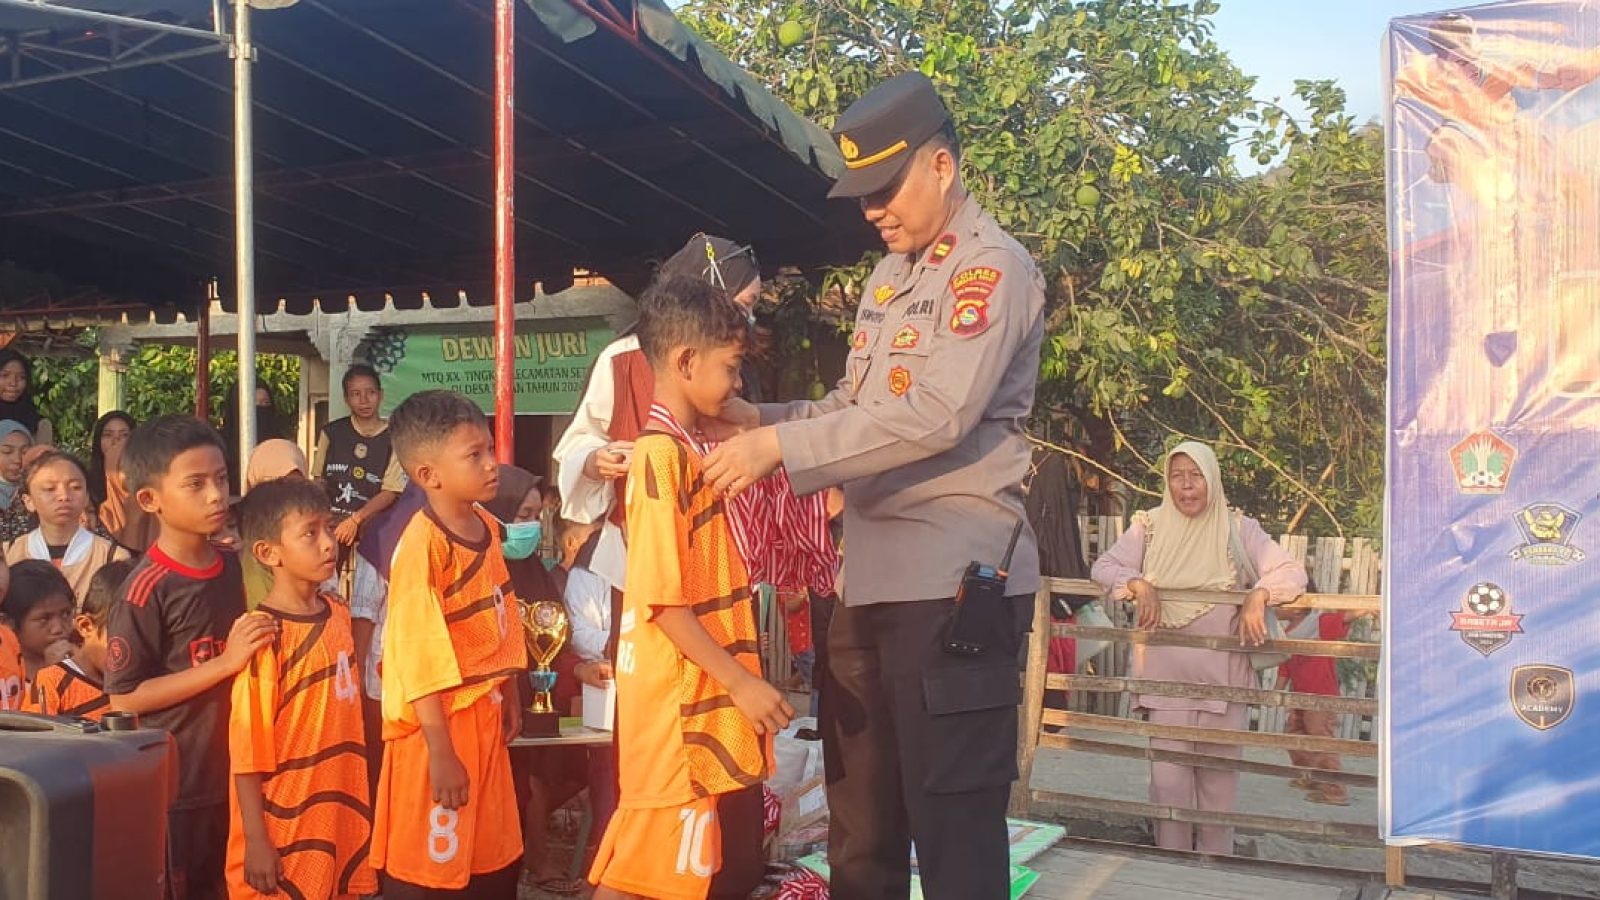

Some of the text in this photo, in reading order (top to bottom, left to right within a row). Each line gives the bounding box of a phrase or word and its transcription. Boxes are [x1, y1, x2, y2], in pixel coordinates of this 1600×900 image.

[442, 331, 587, 365] DEWN JURI
[421, 371, 444, 384] MTQ
[513, 368, 568, 380] ECAMATAN
[465, 384, 491, 395] DESA
[526, 382, 560, 394] TAHUN
[1520, 703, 1563, 714] ACADEMY
[428, 804, 458, 865] 8
